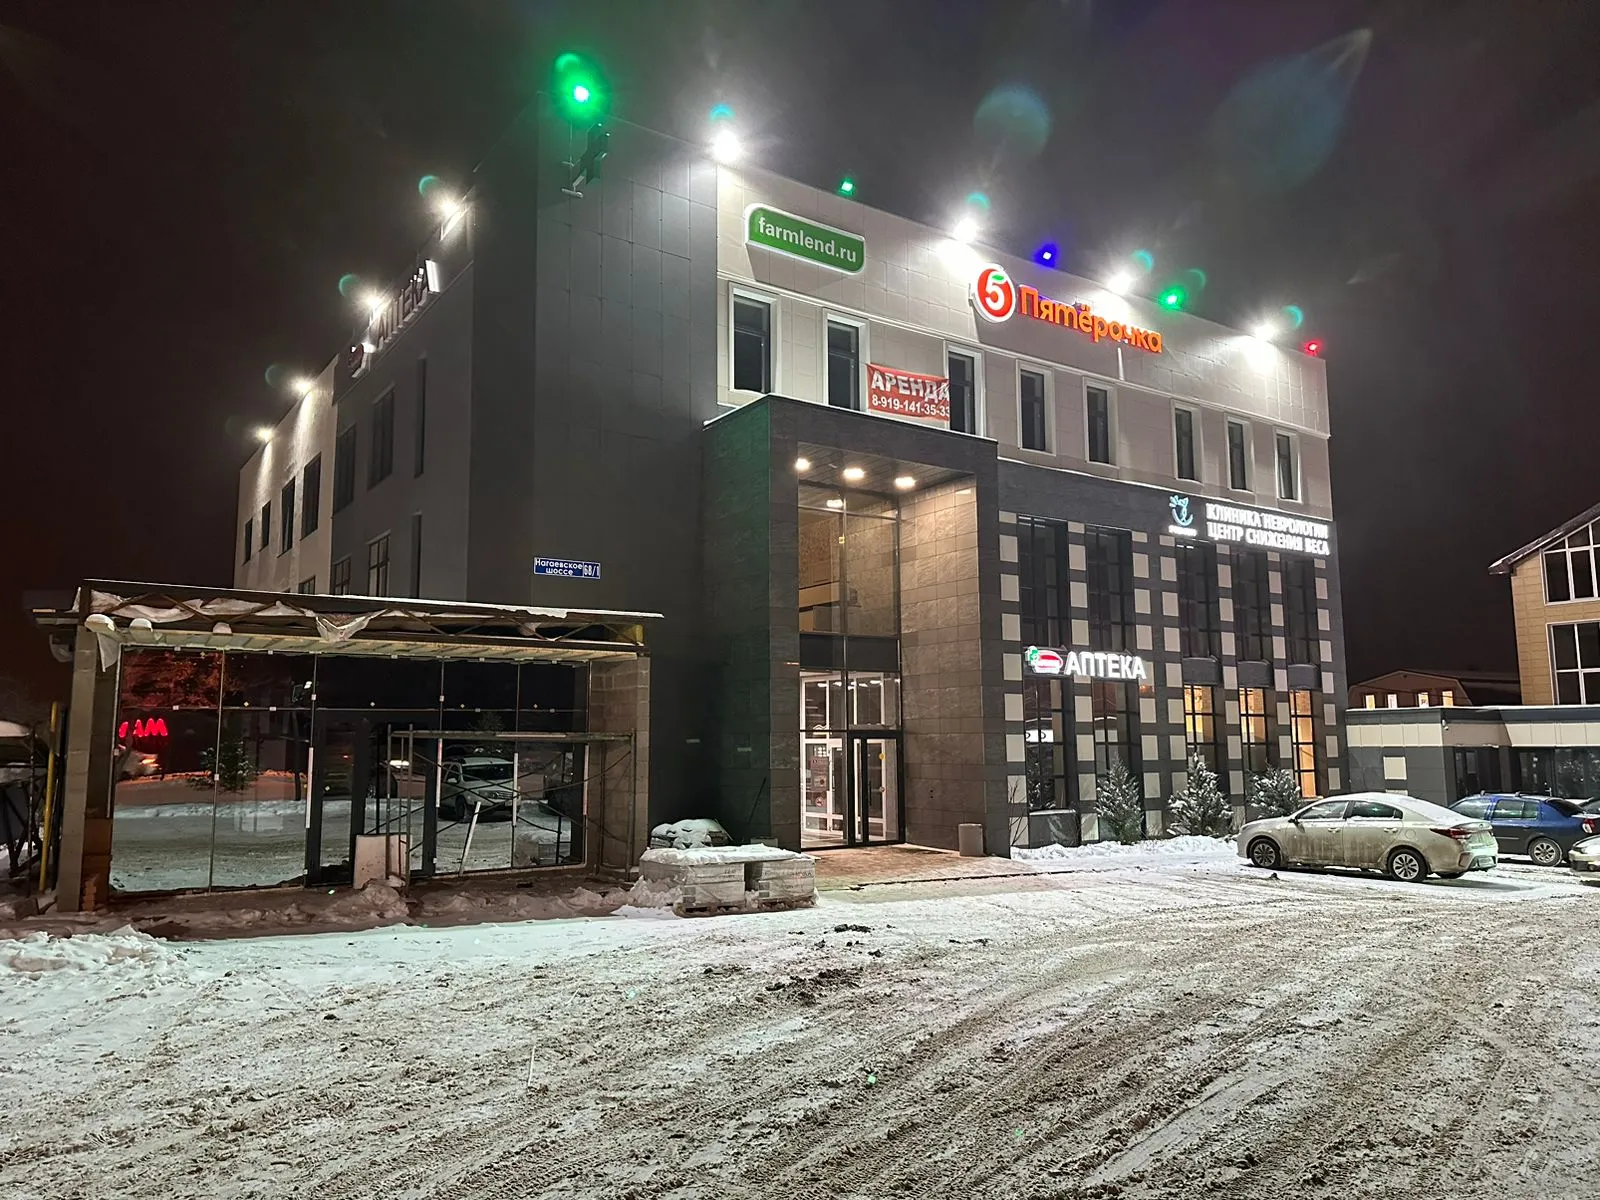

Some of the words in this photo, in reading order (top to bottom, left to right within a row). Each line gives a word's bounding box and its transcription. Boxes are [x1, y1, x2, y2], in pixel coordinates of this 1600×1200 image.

[758, 216, 857, 262] farmlend.ru
[985, 274, 1009, 311] 5
[1019, 285, 1163, 354] Пятёрочка
[871, 371, 949, 403] АРЕНДА
[1206, 503, 1261, 528] КЛИНИКА
[1206, 522, 1244, 541] ЦЕНТР
[1246, 528, 1303, 551] СНИЖЕНИЯ
[1304, 538, 1330, 556] ВЕСА
[535, 558, 583, 570] Нагаевское
[545, 567, 574, 576] шоссе
[1063, 651, 1147, 680] АПТЕКА
